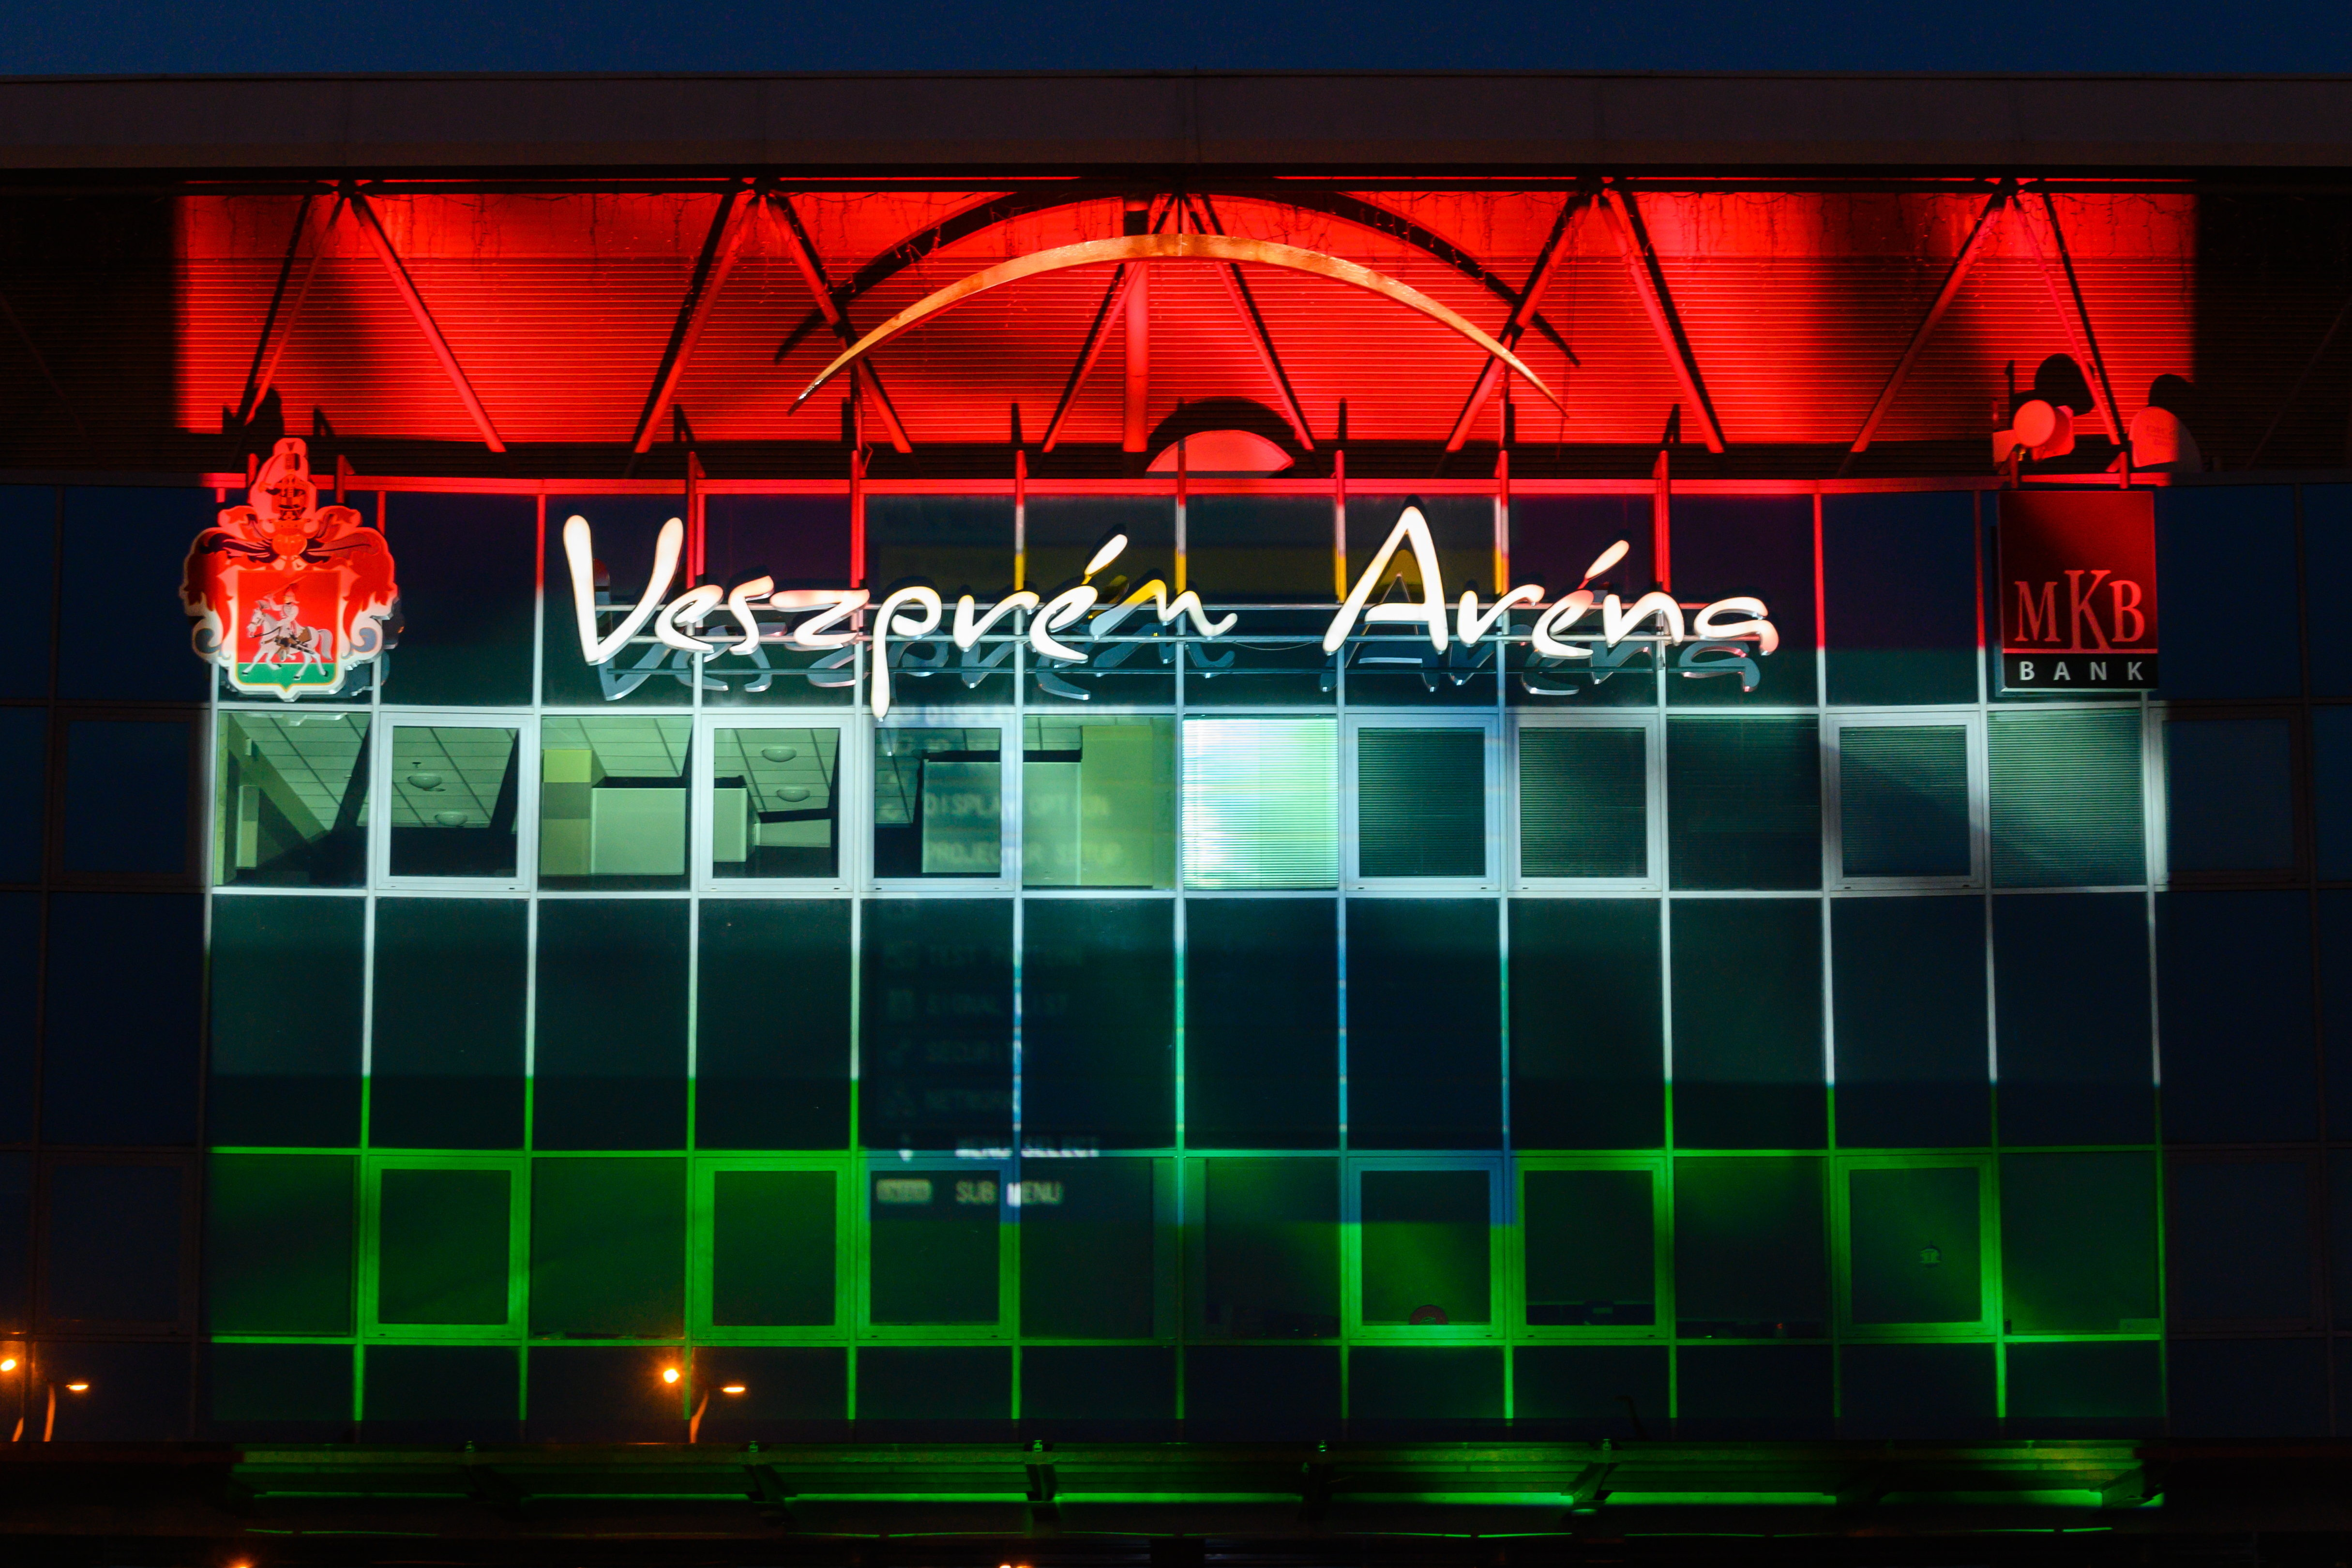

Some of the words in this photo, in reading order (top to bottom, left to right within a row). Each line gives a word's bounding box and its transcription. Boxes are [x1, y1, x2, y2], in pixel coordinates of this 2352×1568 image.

[564, 515, 1237, 721] Veszprém
[1322, 506, 1779, 660] Aréna
[2014, 570, 2145, 653] MKB
[2019, 661, 2143, 680] BANK
